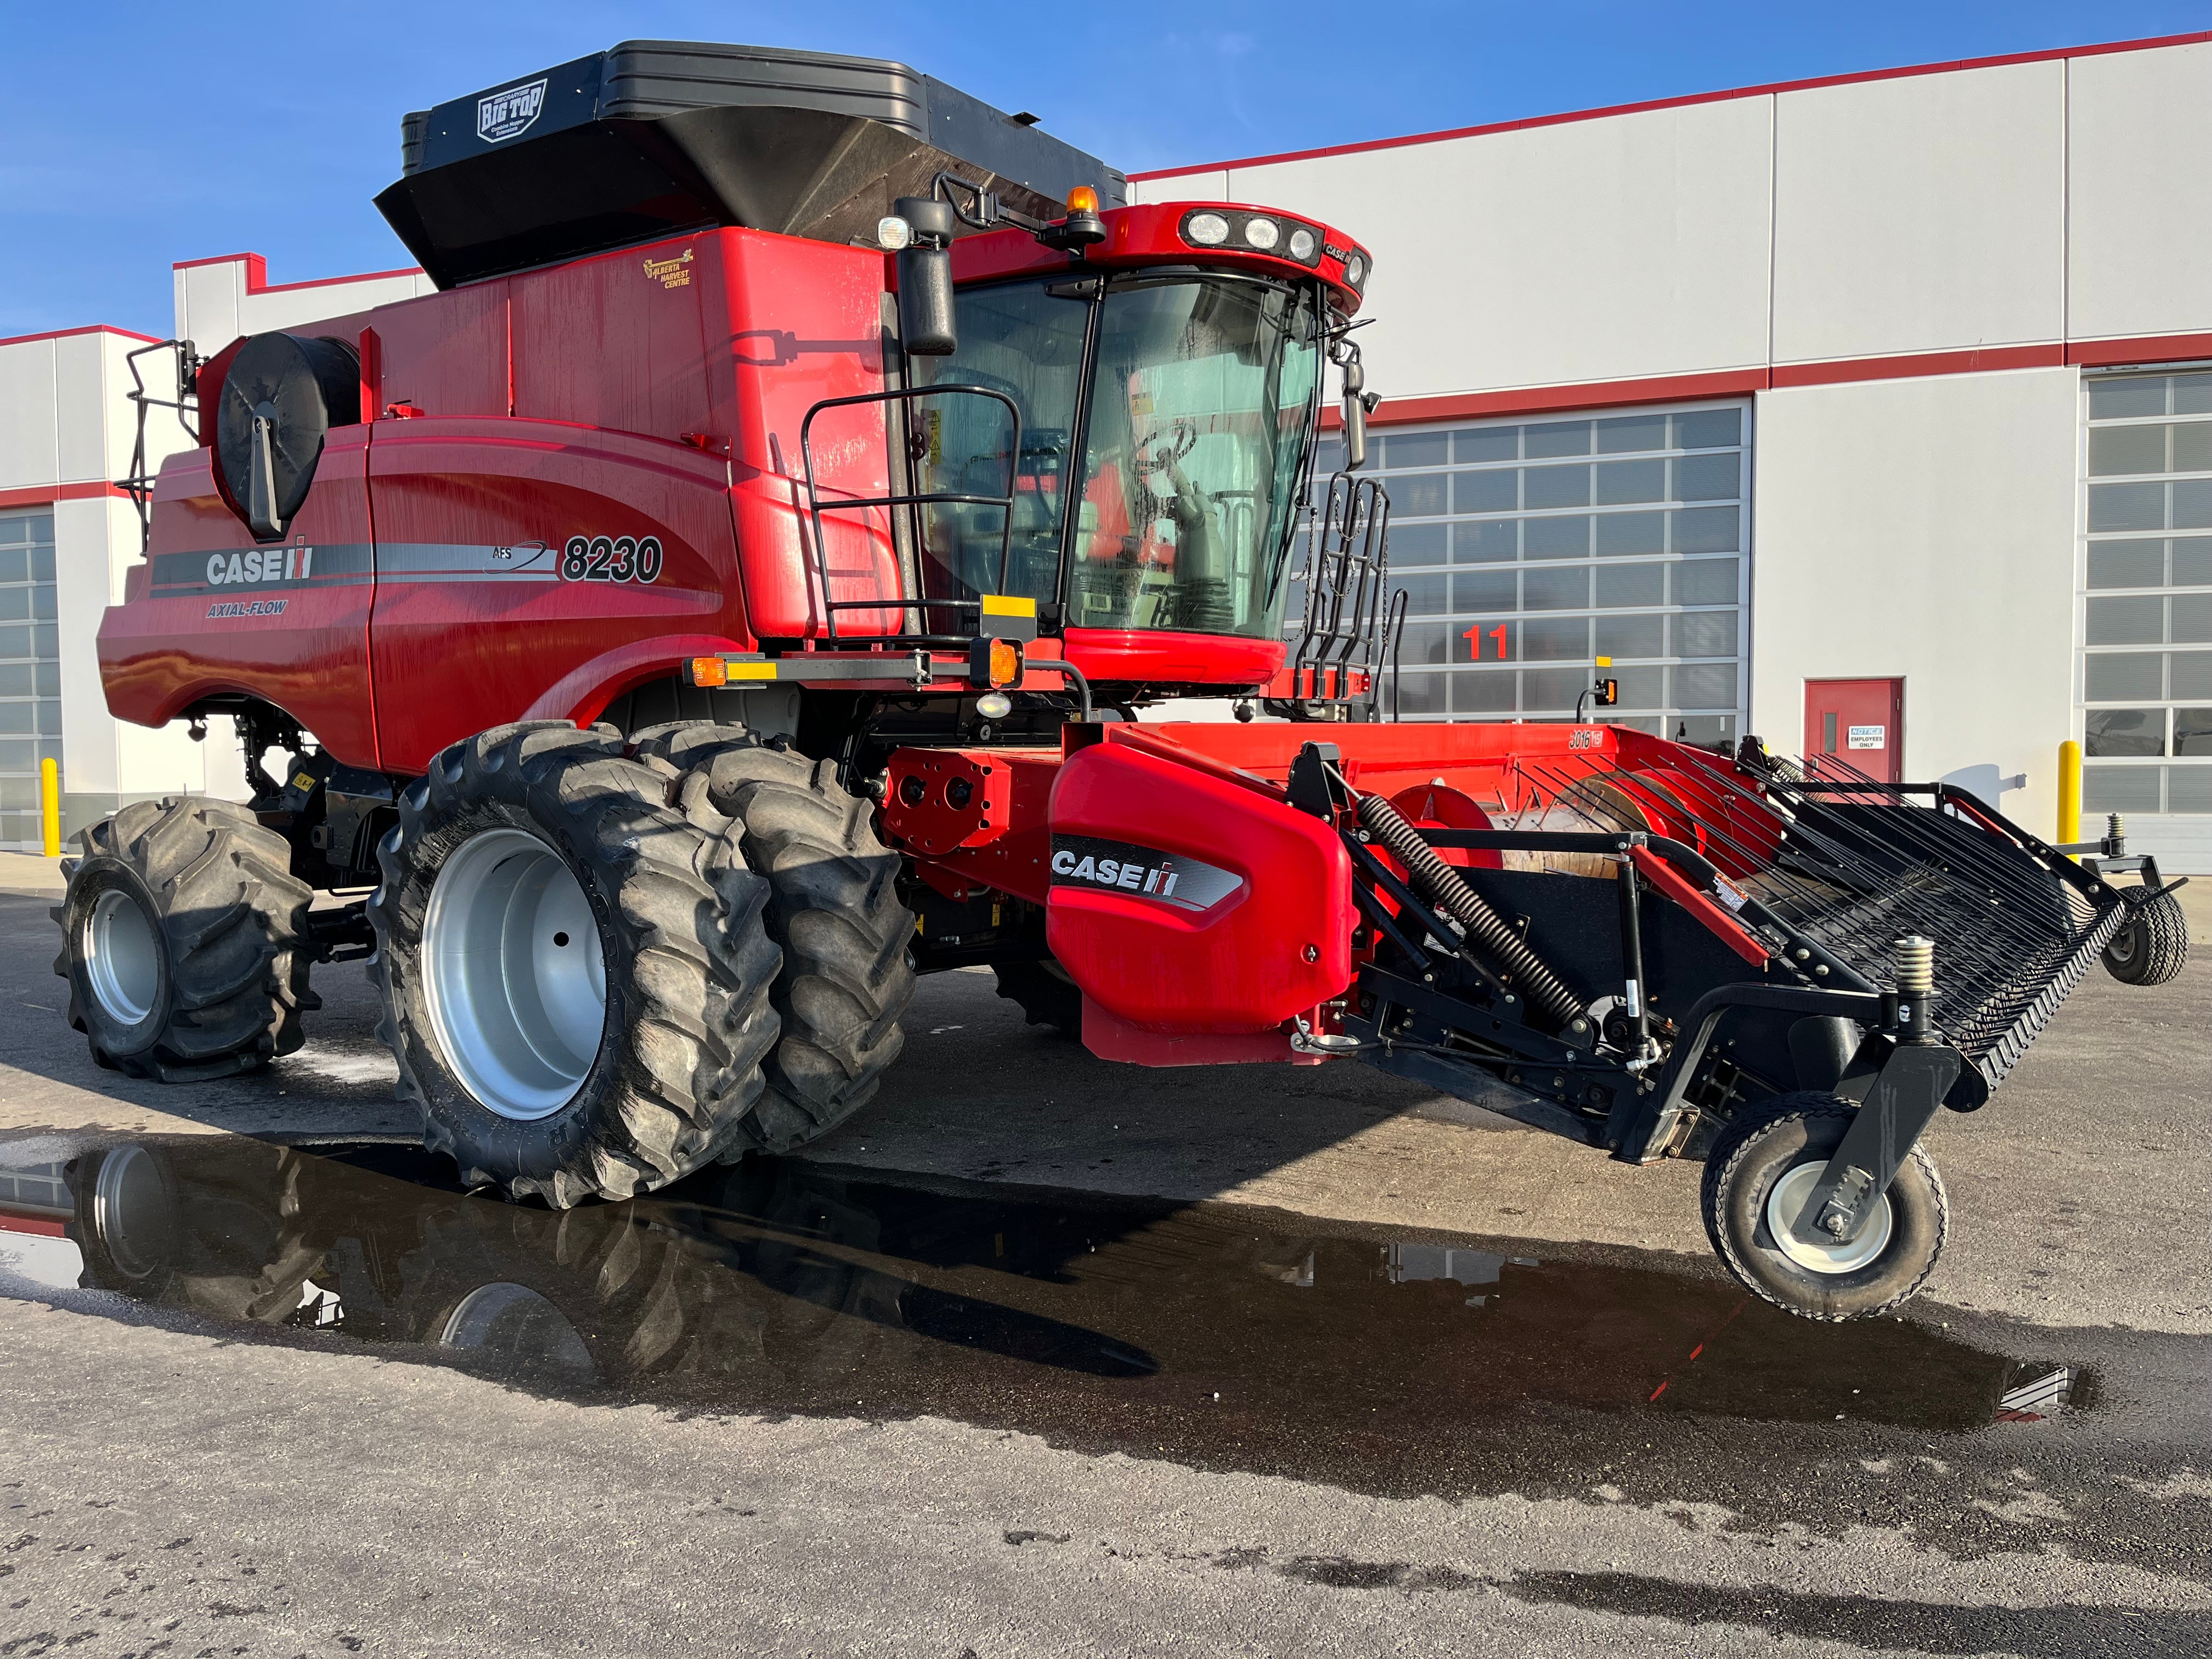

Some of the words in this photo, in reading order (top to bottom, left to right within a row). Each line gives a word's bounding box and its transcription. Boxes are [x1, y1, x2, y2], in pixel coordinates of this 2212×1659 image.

[503, 91, 520, 102] CRARY
[482, 101, 507, 132] BIG
[510, 87, 541, 118] TOP
[491, 123, 509, 133] Combine
[509, 119, 524, 127] Hopper
[496, 126, 518, 136] Extensions
[1326, 245, 1345, 262] CASE
[653, 263, 680, 280] ALBERTA
[661, 269, 690, 282] HARVEST
[664, 276, 690, 289] CENTRE
[493, 547, 511, 559] AFS
[562, 535, 663, 584] 8230
[207, 550, 283, 585] CASE
[206, 600, 289, 618] AXIAL-FLOW
[1463, 624, 1506, 659] 11
[1052, 850, 1145, 890] CASE
